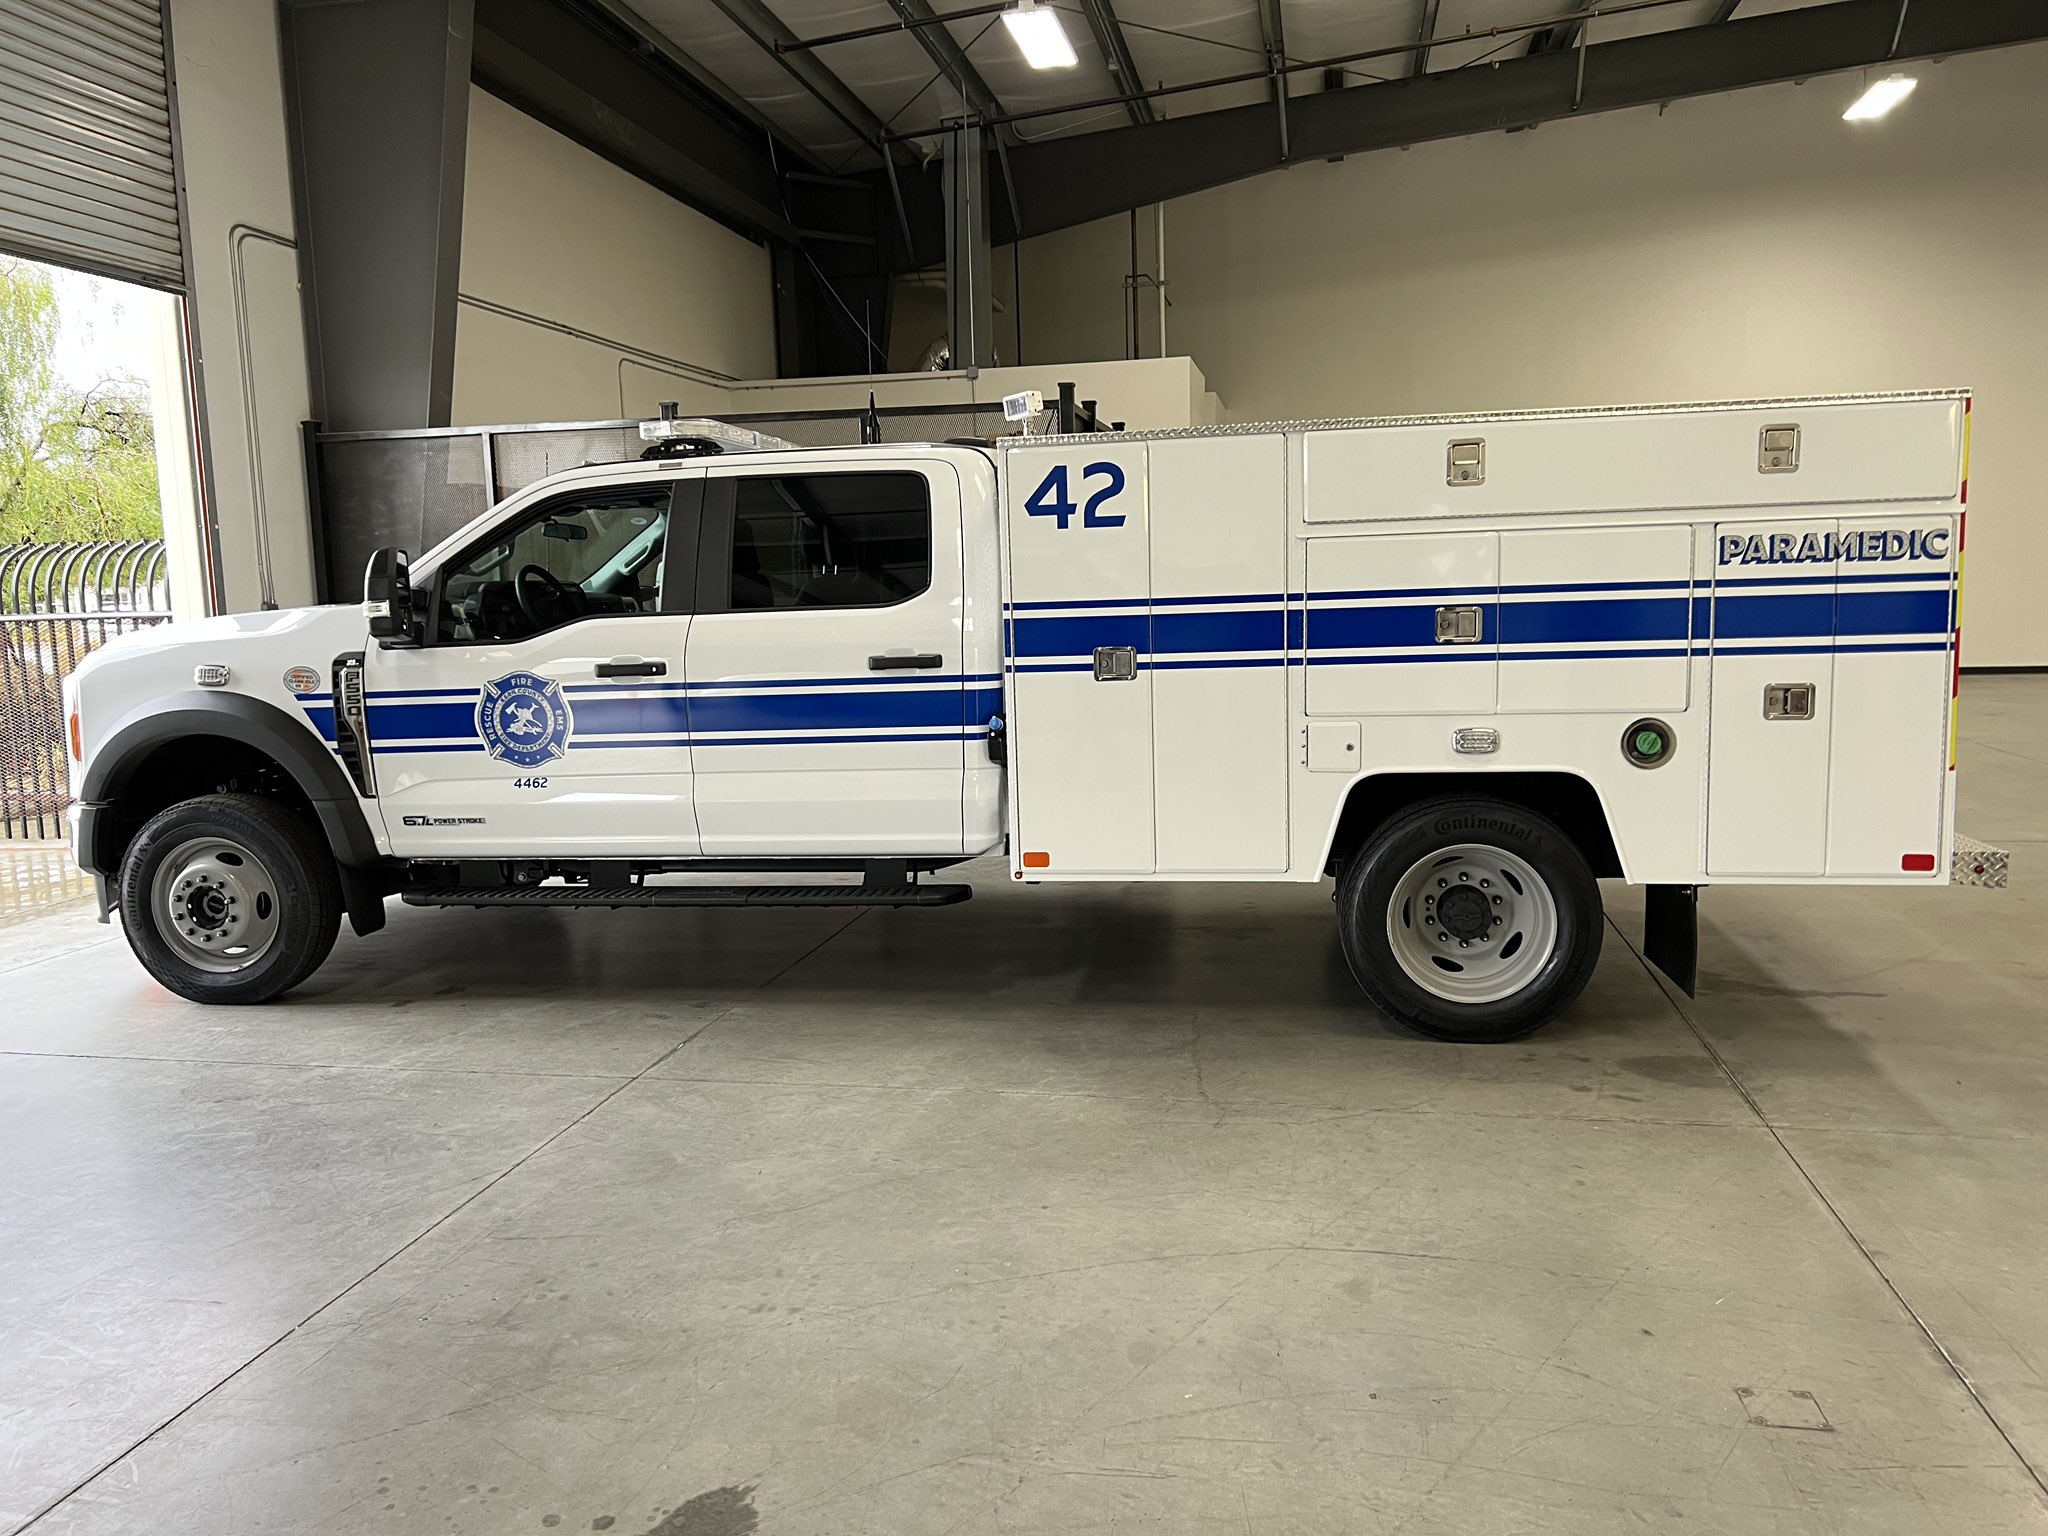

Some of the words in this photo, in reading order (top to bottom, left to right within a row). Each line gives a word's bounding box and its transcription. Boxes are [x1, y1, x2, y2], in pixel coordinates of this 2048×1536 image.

[1024, 461, 1127, 530] 42
[1718, 528, 1950, 566] PARAMEDIC
[510, 677, 533, 687] FIRE
[500, 690, 517, 703] KERN
[518, 688, 545, 702] COUNTY
[484, 701, 497, 740] RESCUE
[555, 709, 564, 731] EMS
[512, 733, 552, 752] DEPARTMENT
[513, 777, 549, 789] 4462
[1434, 814, 1533, 842] Continental
